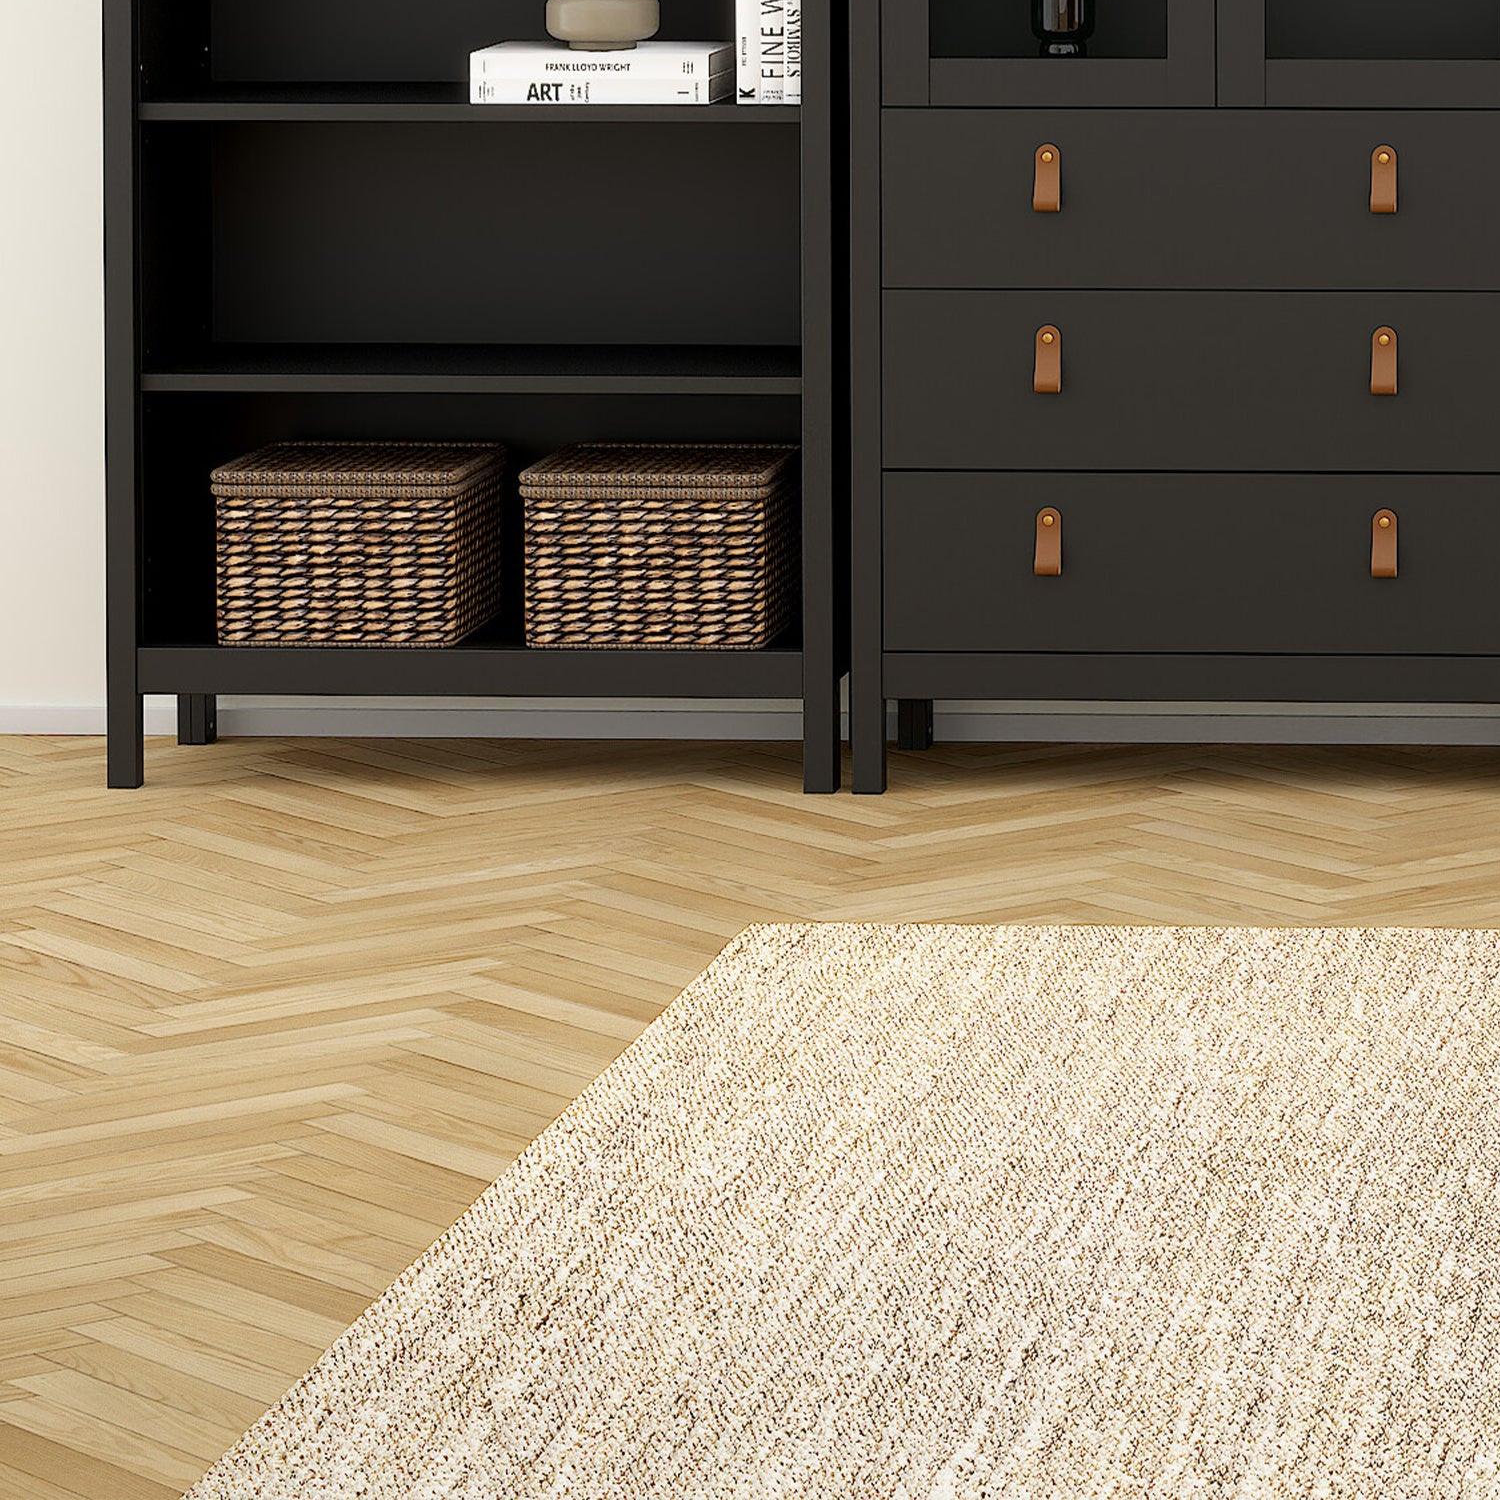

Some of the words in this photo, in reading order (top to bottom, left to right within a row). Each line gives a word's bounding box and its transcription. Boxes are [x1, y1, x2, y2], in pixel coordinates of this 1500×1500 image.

[761, 27, 784, 79] FINE
[787, 9, 801, 78] SYMBOLS
[545, 63, 571, 72] FRANK
[572, 63, 598, 72] LLOYD
[600, 63, 630, 72] WRIGHT
[527, 83, 563, 102] ART
